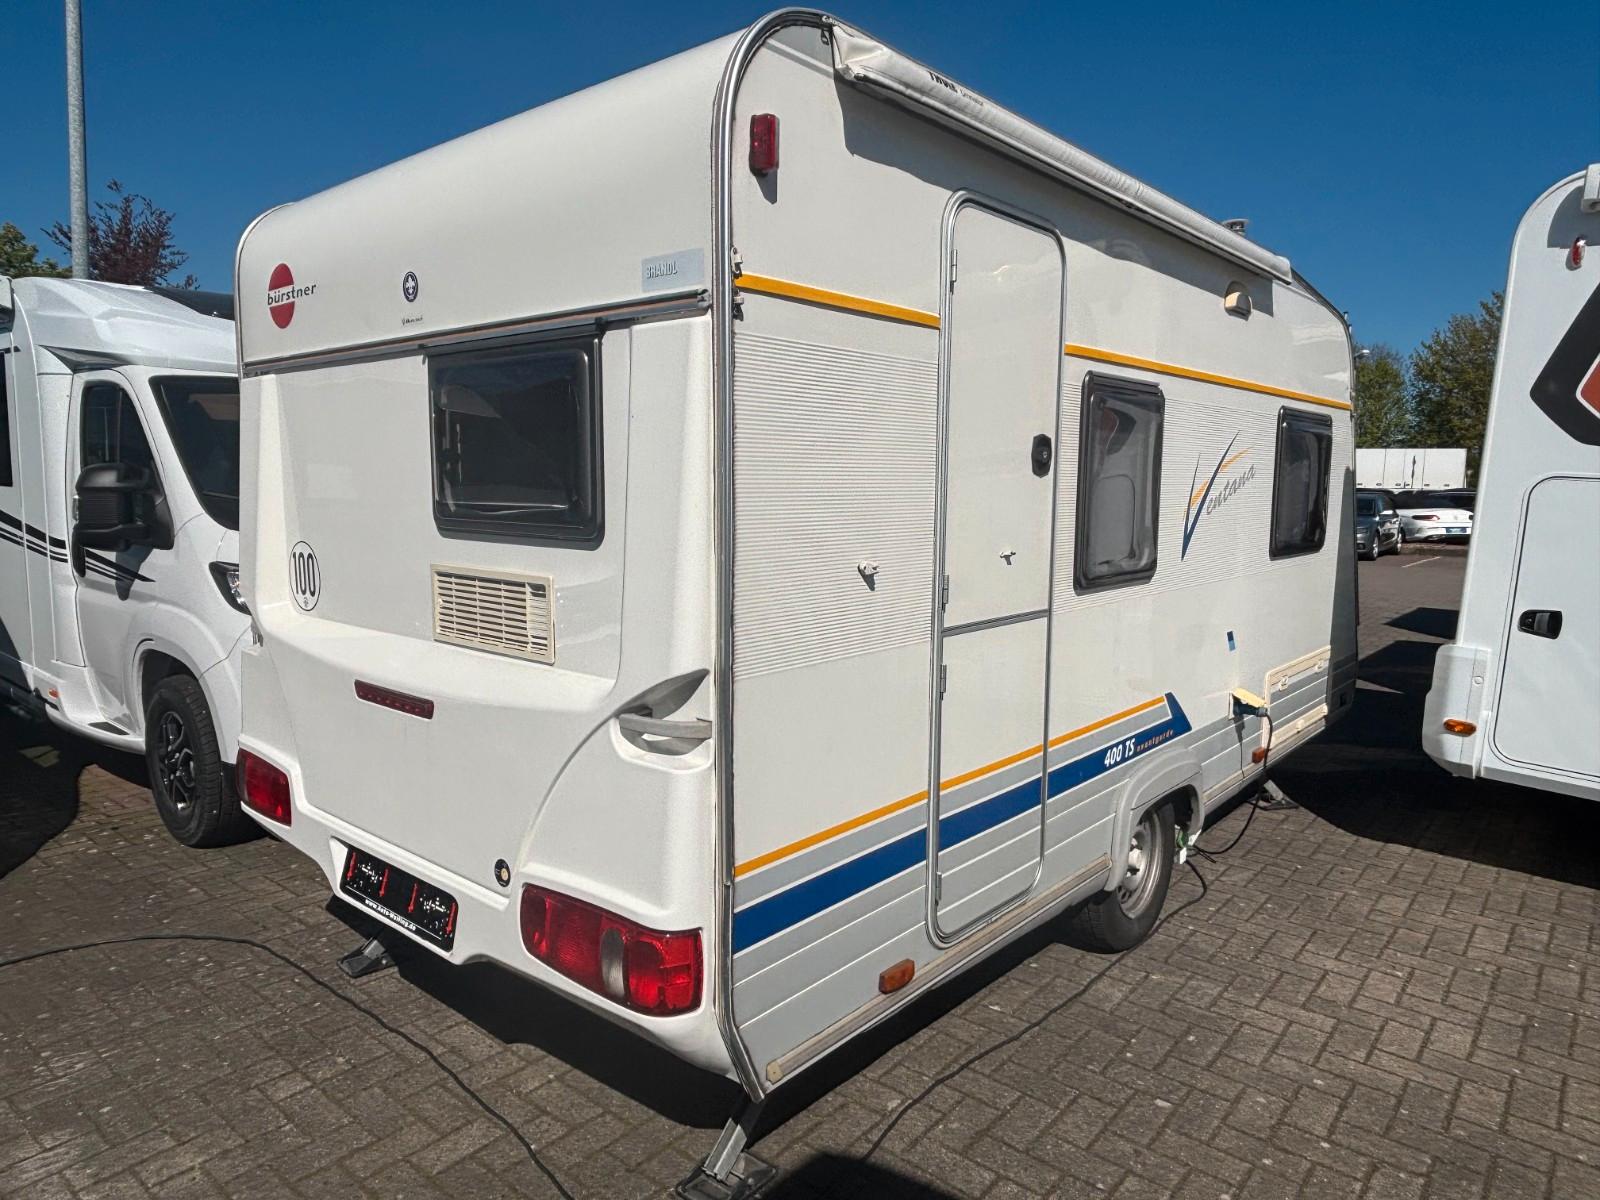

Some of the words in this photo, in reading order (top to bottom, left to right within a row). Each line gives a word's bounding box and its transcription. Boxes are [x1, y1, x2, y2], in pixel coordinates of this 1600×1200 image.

[267, 283, 317, 306] bürstner
[293, 552, 316, 597] 100
[1104, 744, 1123, 767] 400
[1125, 738, 1136, 758] TS
